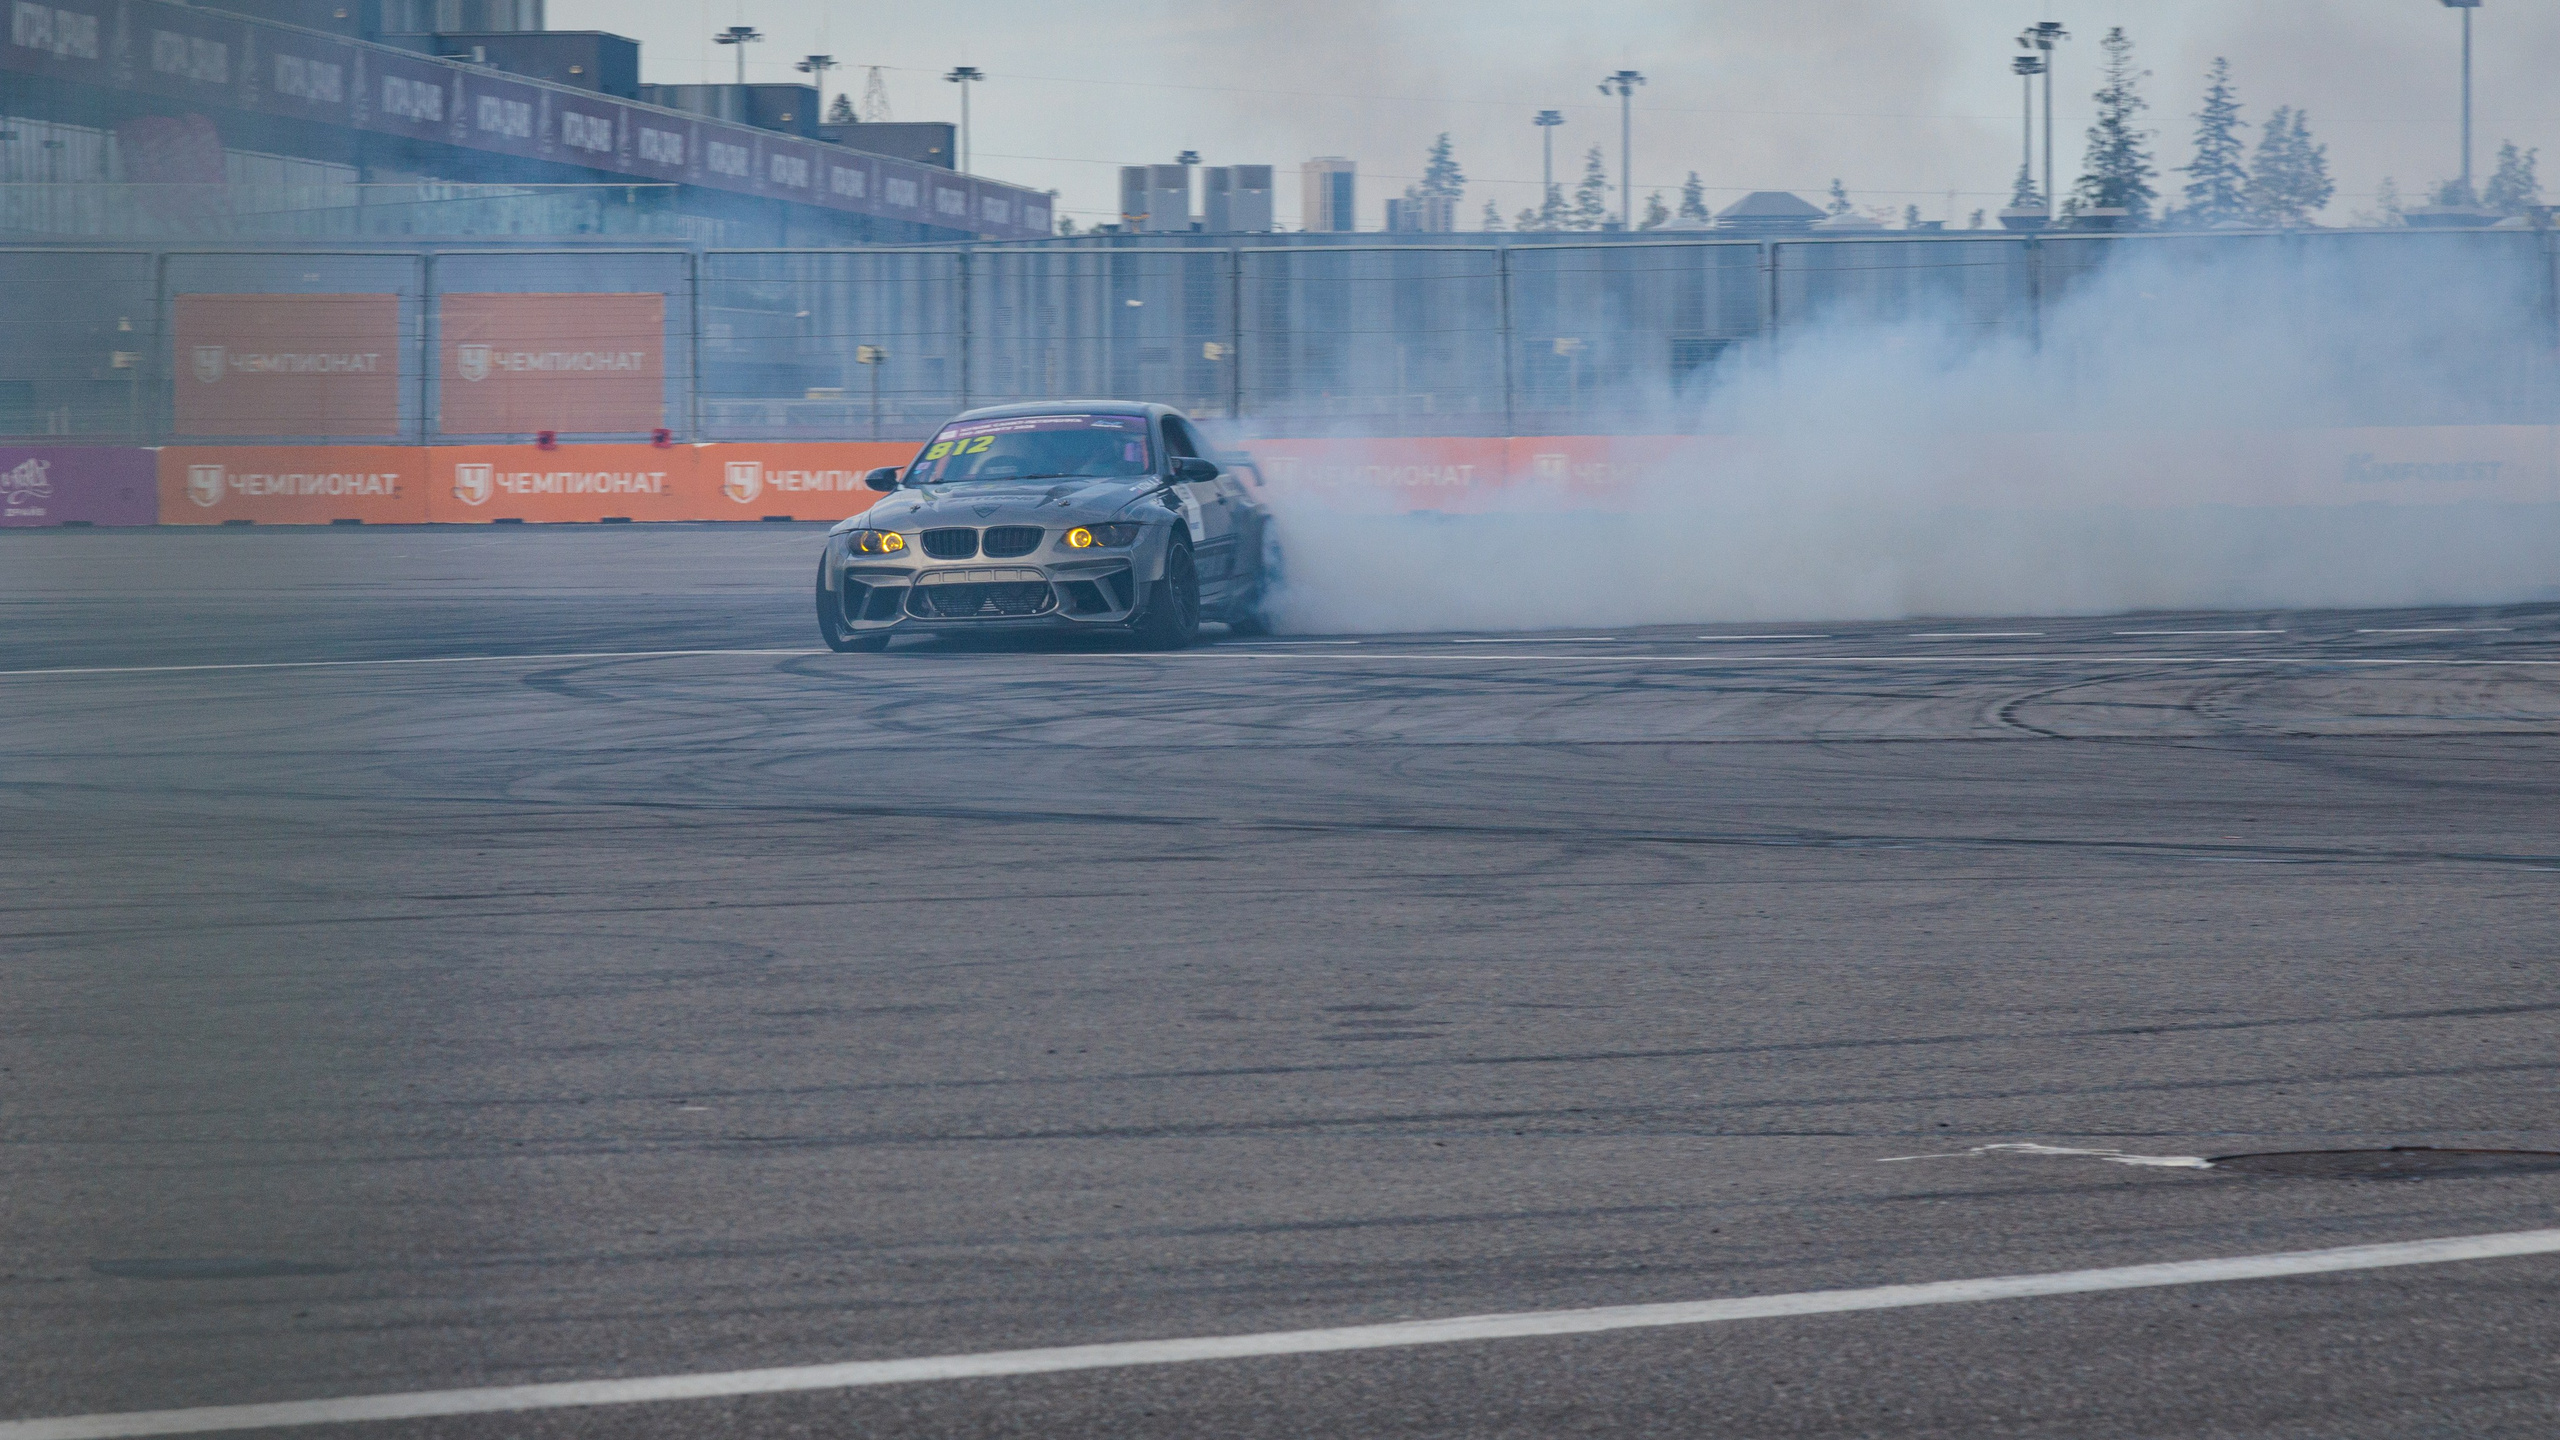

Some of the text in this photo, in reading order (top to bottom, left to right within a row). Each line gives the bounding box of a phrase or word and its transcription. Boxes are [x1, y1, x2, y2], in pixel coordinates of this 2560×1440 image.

[229, 353, 381, 373] ЧЕМПИОНАТ
[494, 351, 646, 371] ЧЕМПИОНАТ
[925, 435, 996, 461] 812
[228, 473, 400, 496] ЧЕМПИОНАТ
[496, 471, 668, 494] ЧЕМПИОНАТ
[765, 470, 874, 492] ЧЕМПИ
